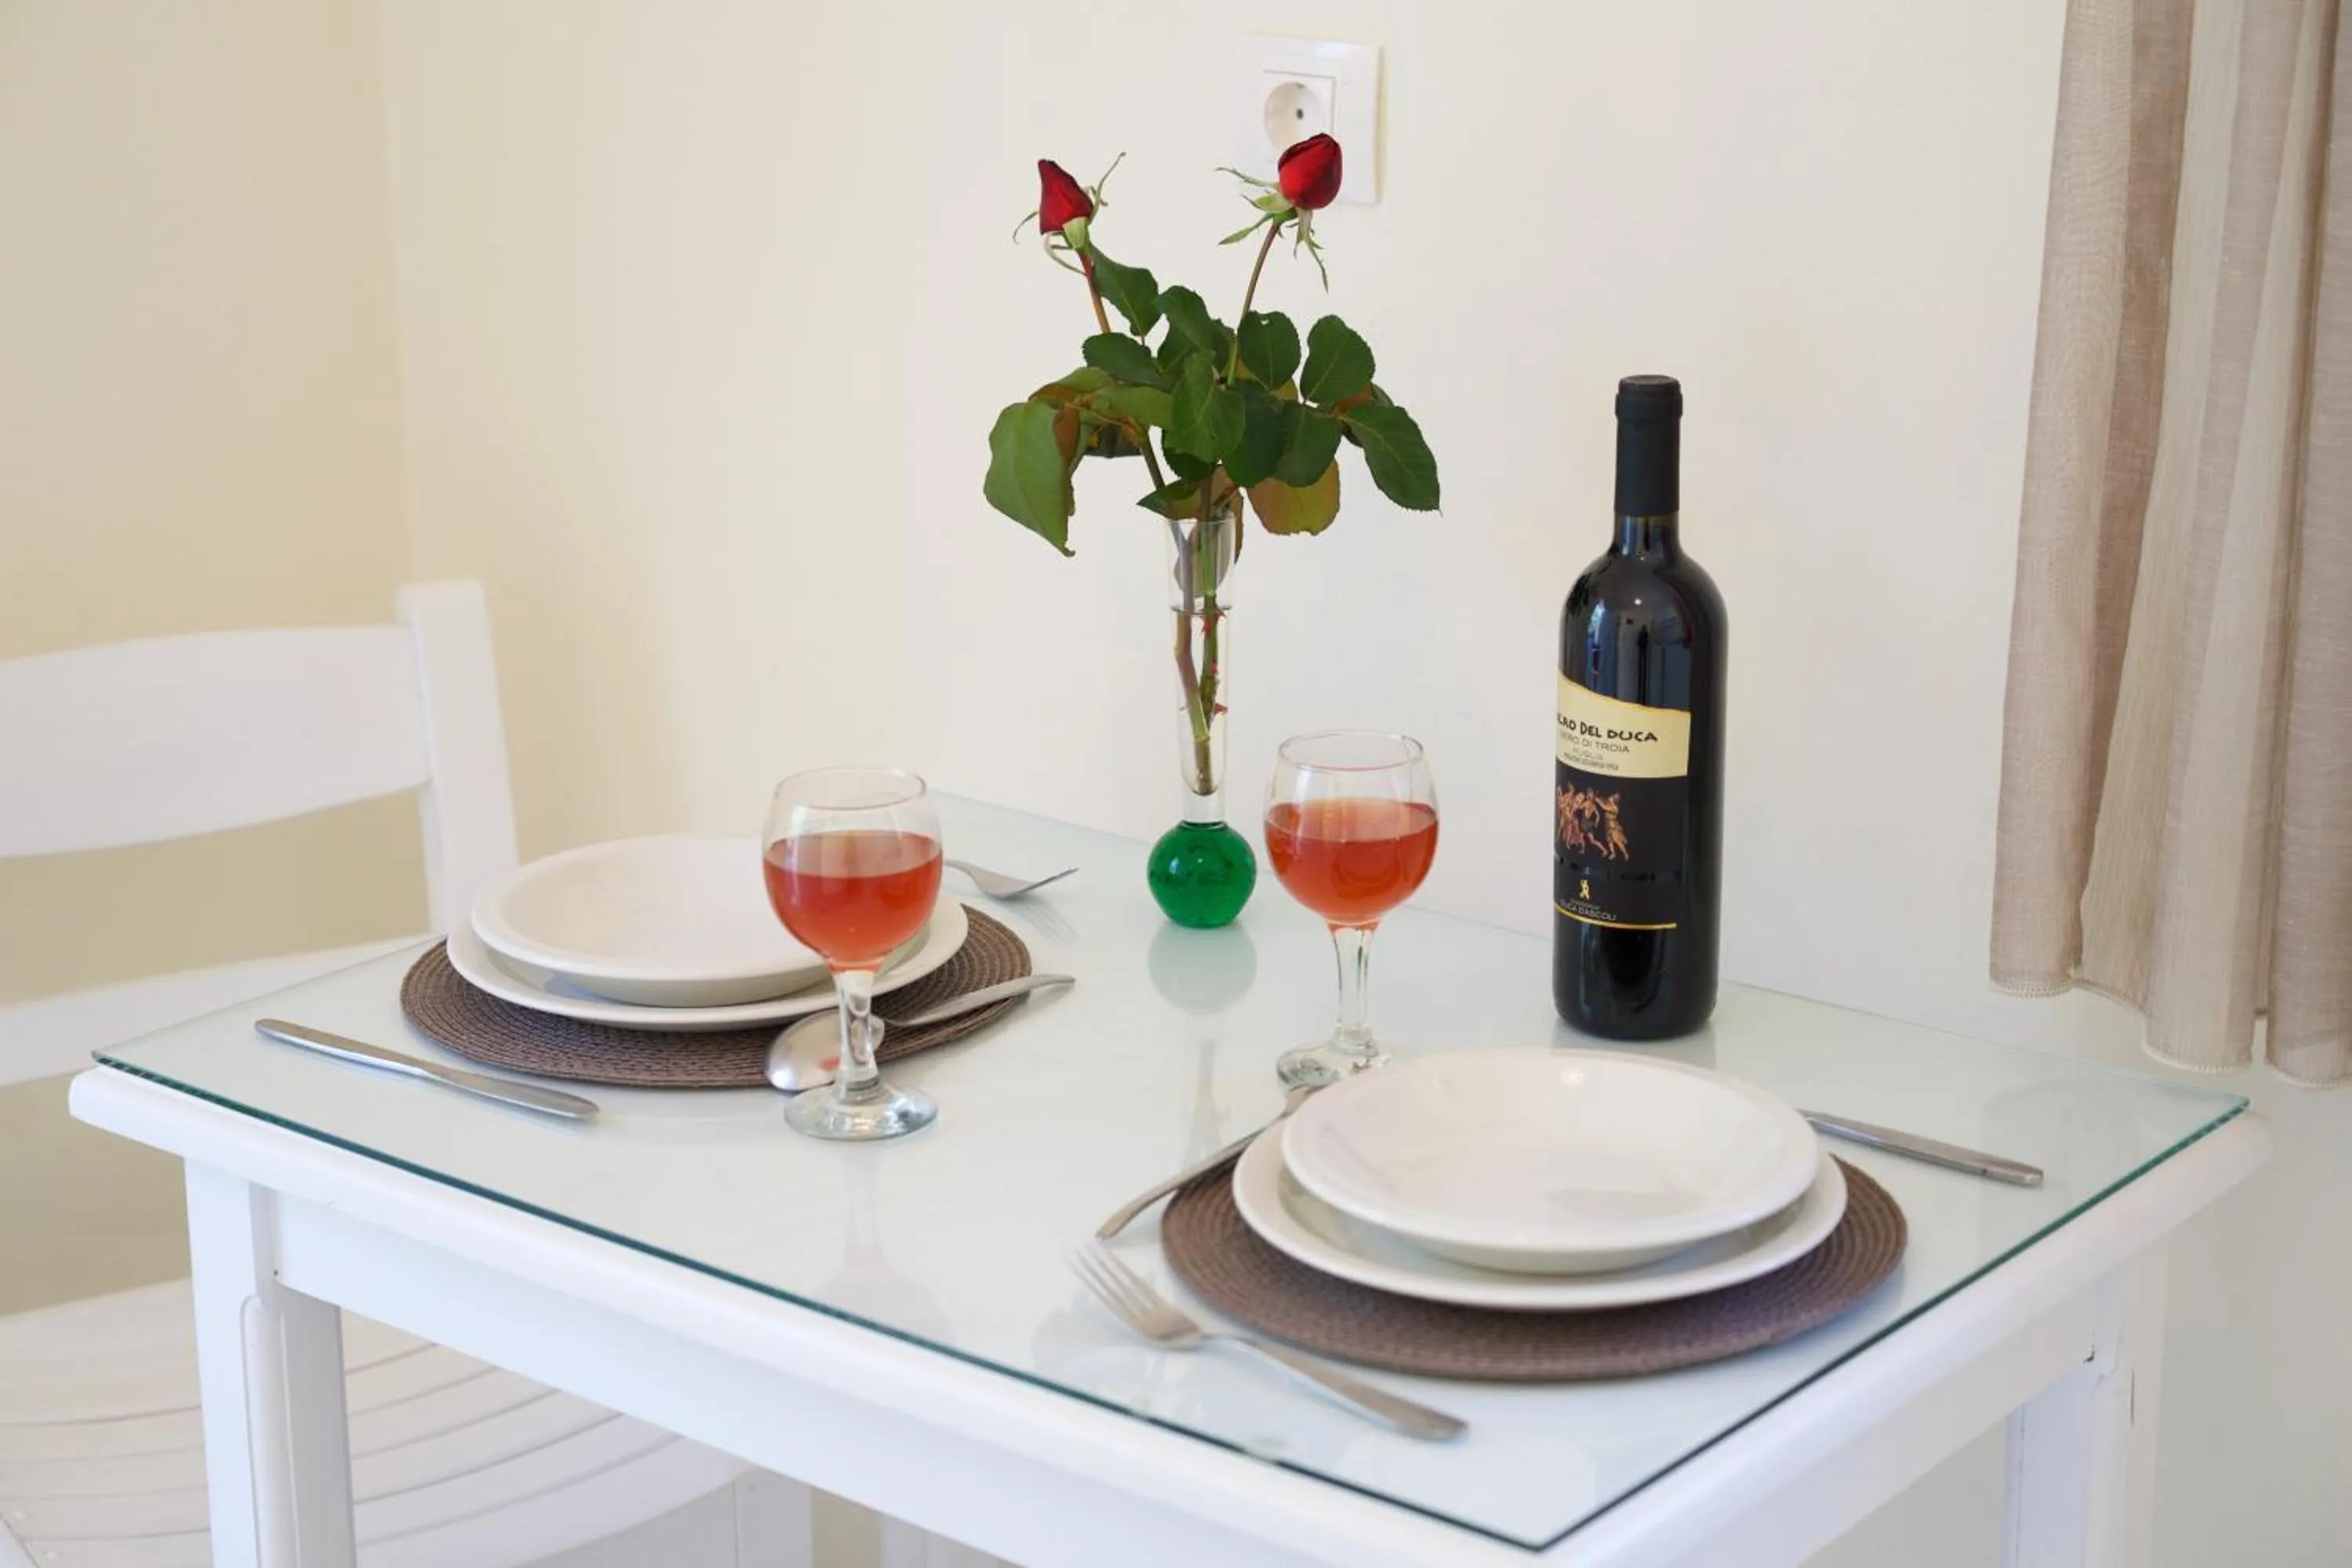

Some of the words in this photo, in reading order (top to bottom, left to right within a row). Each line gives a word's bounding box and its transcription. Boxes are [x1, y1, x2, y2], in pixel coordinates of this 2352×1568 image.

[1580, 720, 1602, 739] DEL
[1606, 729, 1658, 742] DUCA
[1582, 737, 1592, 748] DI
[1595, 741, 1631, 753] TROIA
